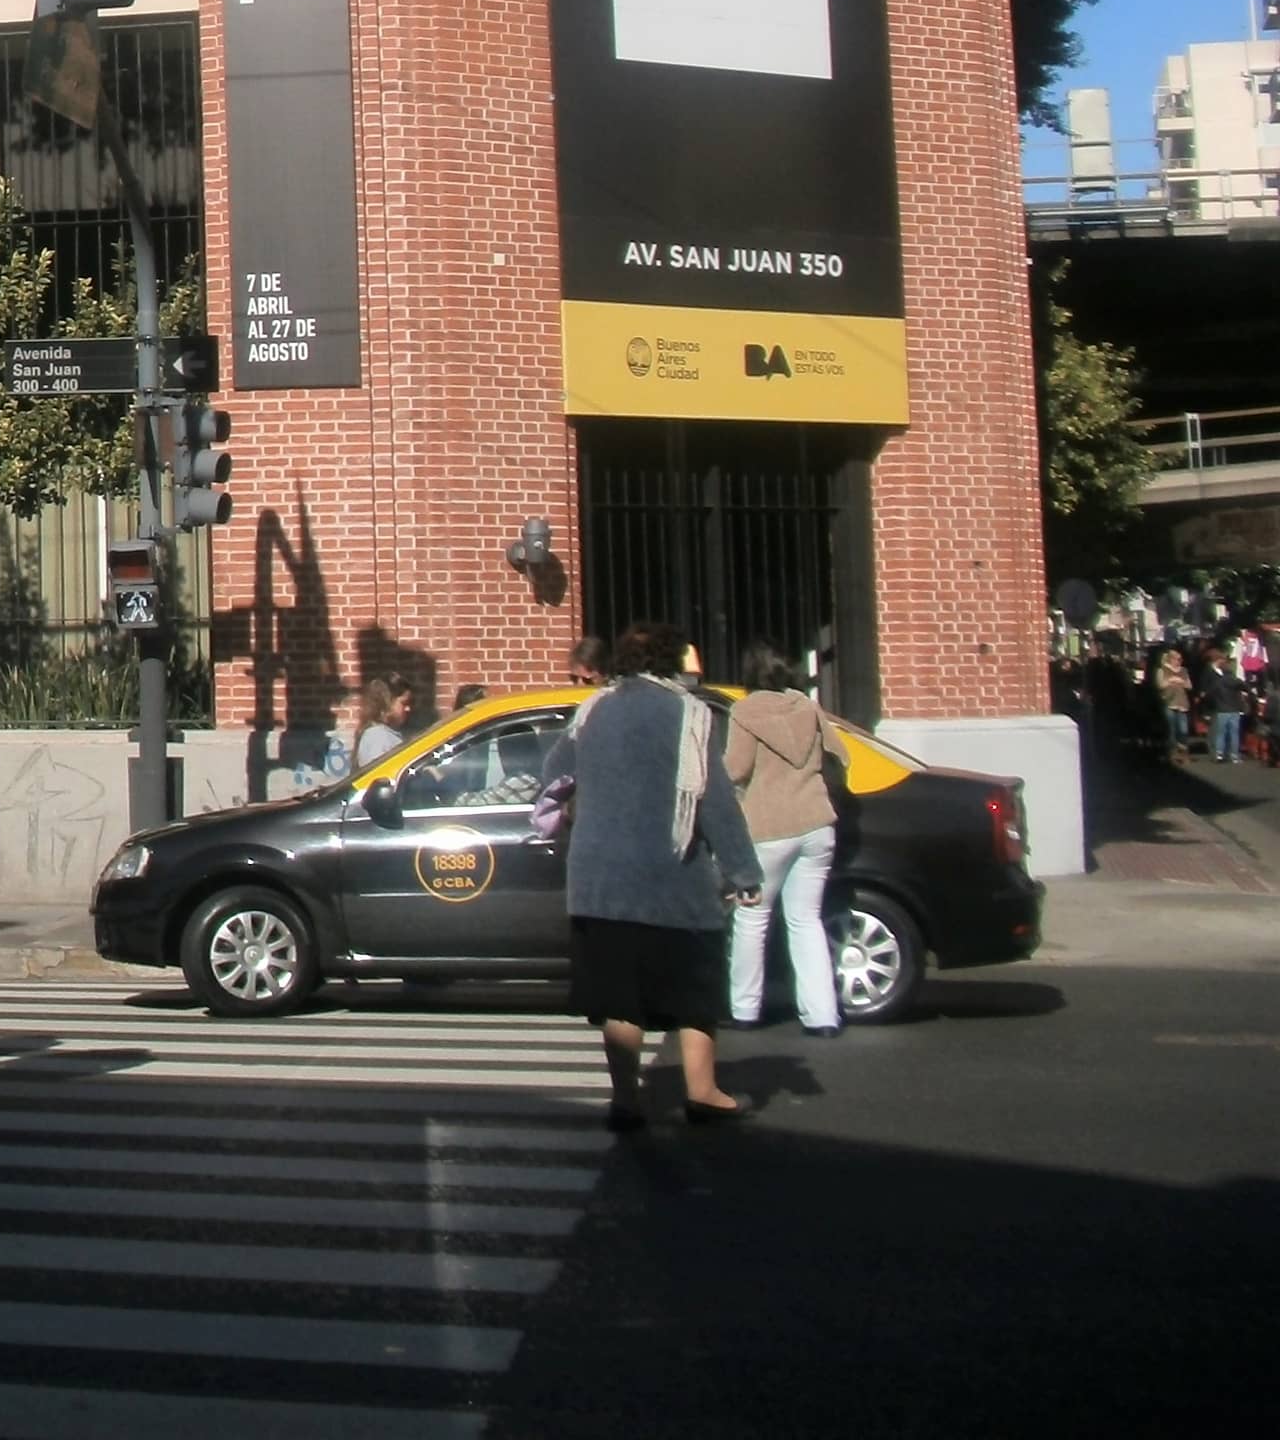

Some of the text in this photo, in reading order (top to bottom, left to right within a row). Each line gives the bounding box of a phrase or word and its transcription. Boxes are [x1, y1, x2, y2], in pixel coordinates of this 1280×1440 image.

[623, 241, 844, 278] AV. SAN JUAN 350
[246, 273, 281, 293] 7 DE
[247, 296, 293, 316] ABRIL
[248, 318, 316, 339] AL 27 DE
[13, 346, 72, 360] Avenida
[248, 342, 308, 362] AGOSTO
[656, 338, 700, 353] Buenos
[656, 352, 687, 366] Aires
[743, 343, 792, 380] BA
[13, 362, 81, 377] San Juan
[656, 365, 699, 380] Ciudad
[13, 380, 40, 393] 300
[52, 379, 79, 392] 400
[433, 876, 475, 889] GCBA
